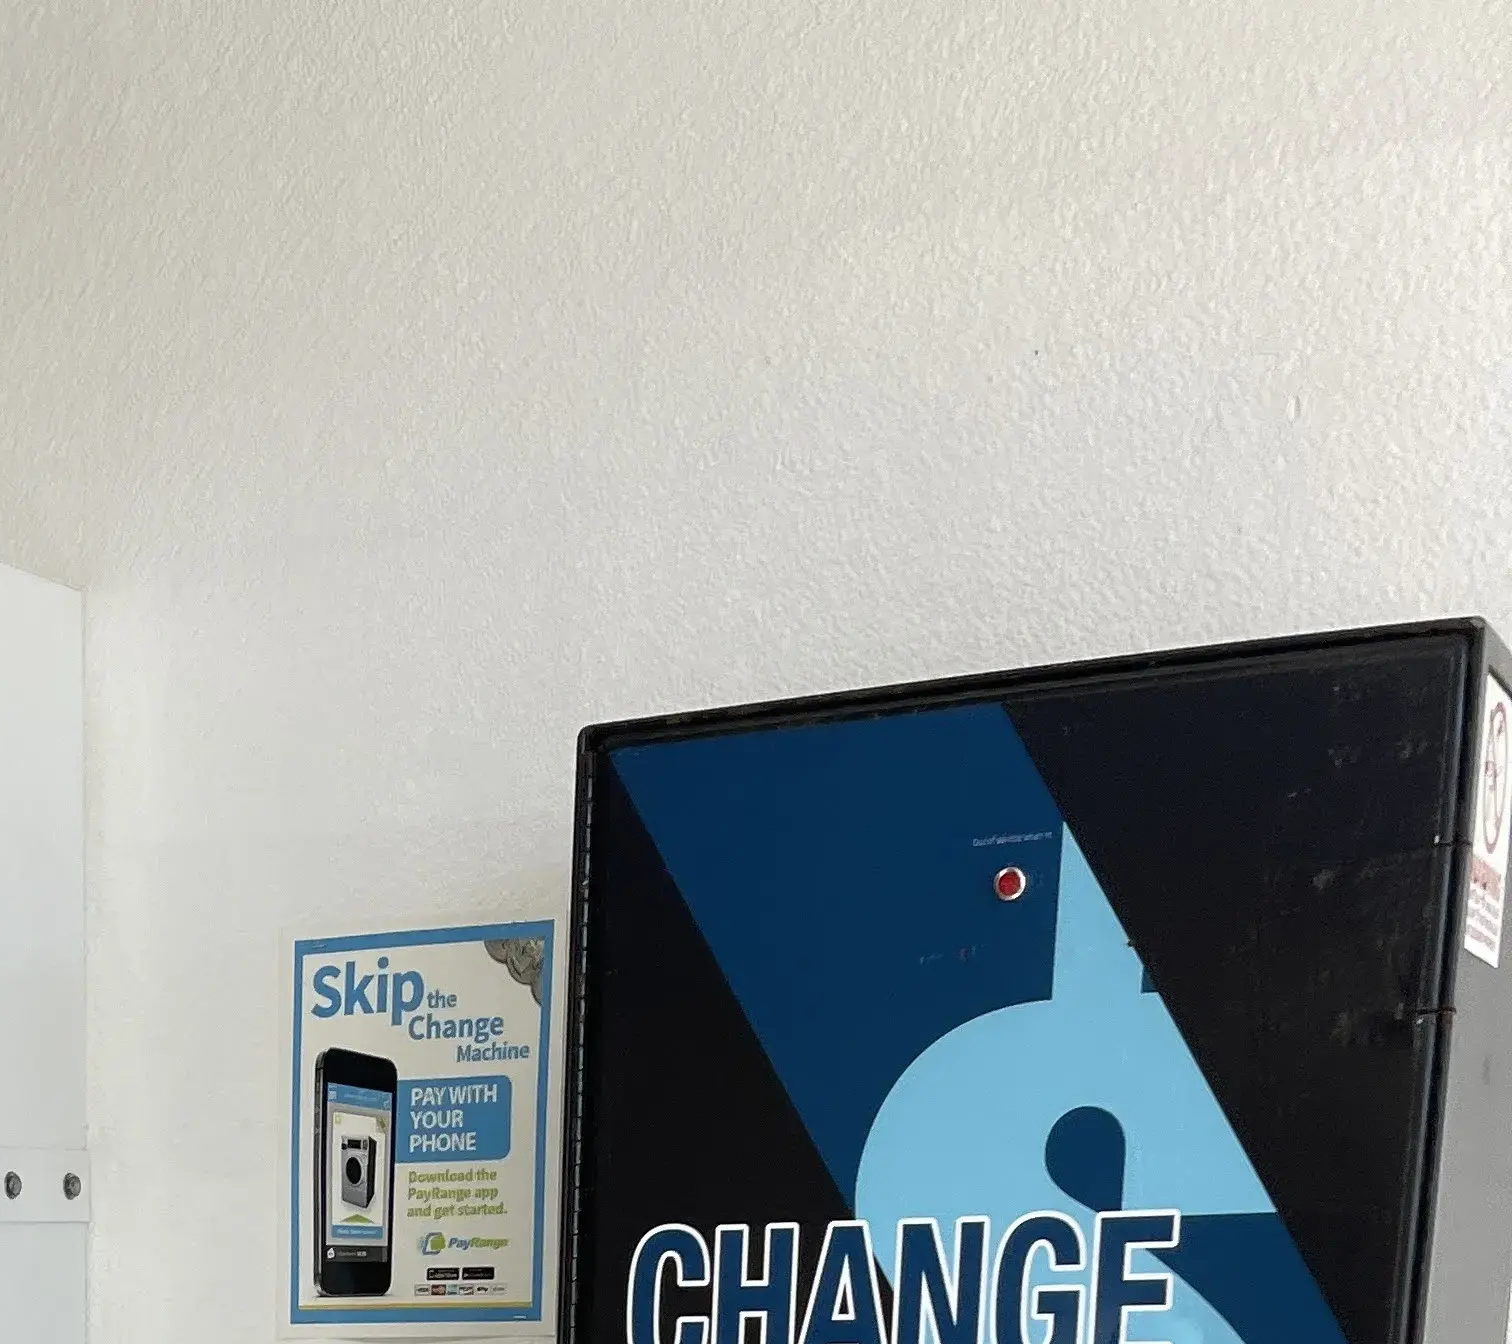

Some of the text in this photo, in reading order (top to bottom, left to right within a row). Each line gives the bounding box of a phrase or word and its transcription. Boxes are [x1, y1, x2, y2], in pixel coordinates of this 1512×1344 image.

[311, 956, 457, 1026] Skip the
[408, 1015, 505, 1046] Change
[456, 1041, 530, 1064] Machine
[411, 1084, 498, 1108] PAY WITH
[410, 1110, 464, 1131] YOUR
[409, 1131, 477, 1153] PHONE
[408, 1168, 497, 1184] Download the
[408, 1187, 499, 1203] PayRange app
[407, 1201, 508, 1219] and get started.
[448, 1237, 509, 1250] PayRange
